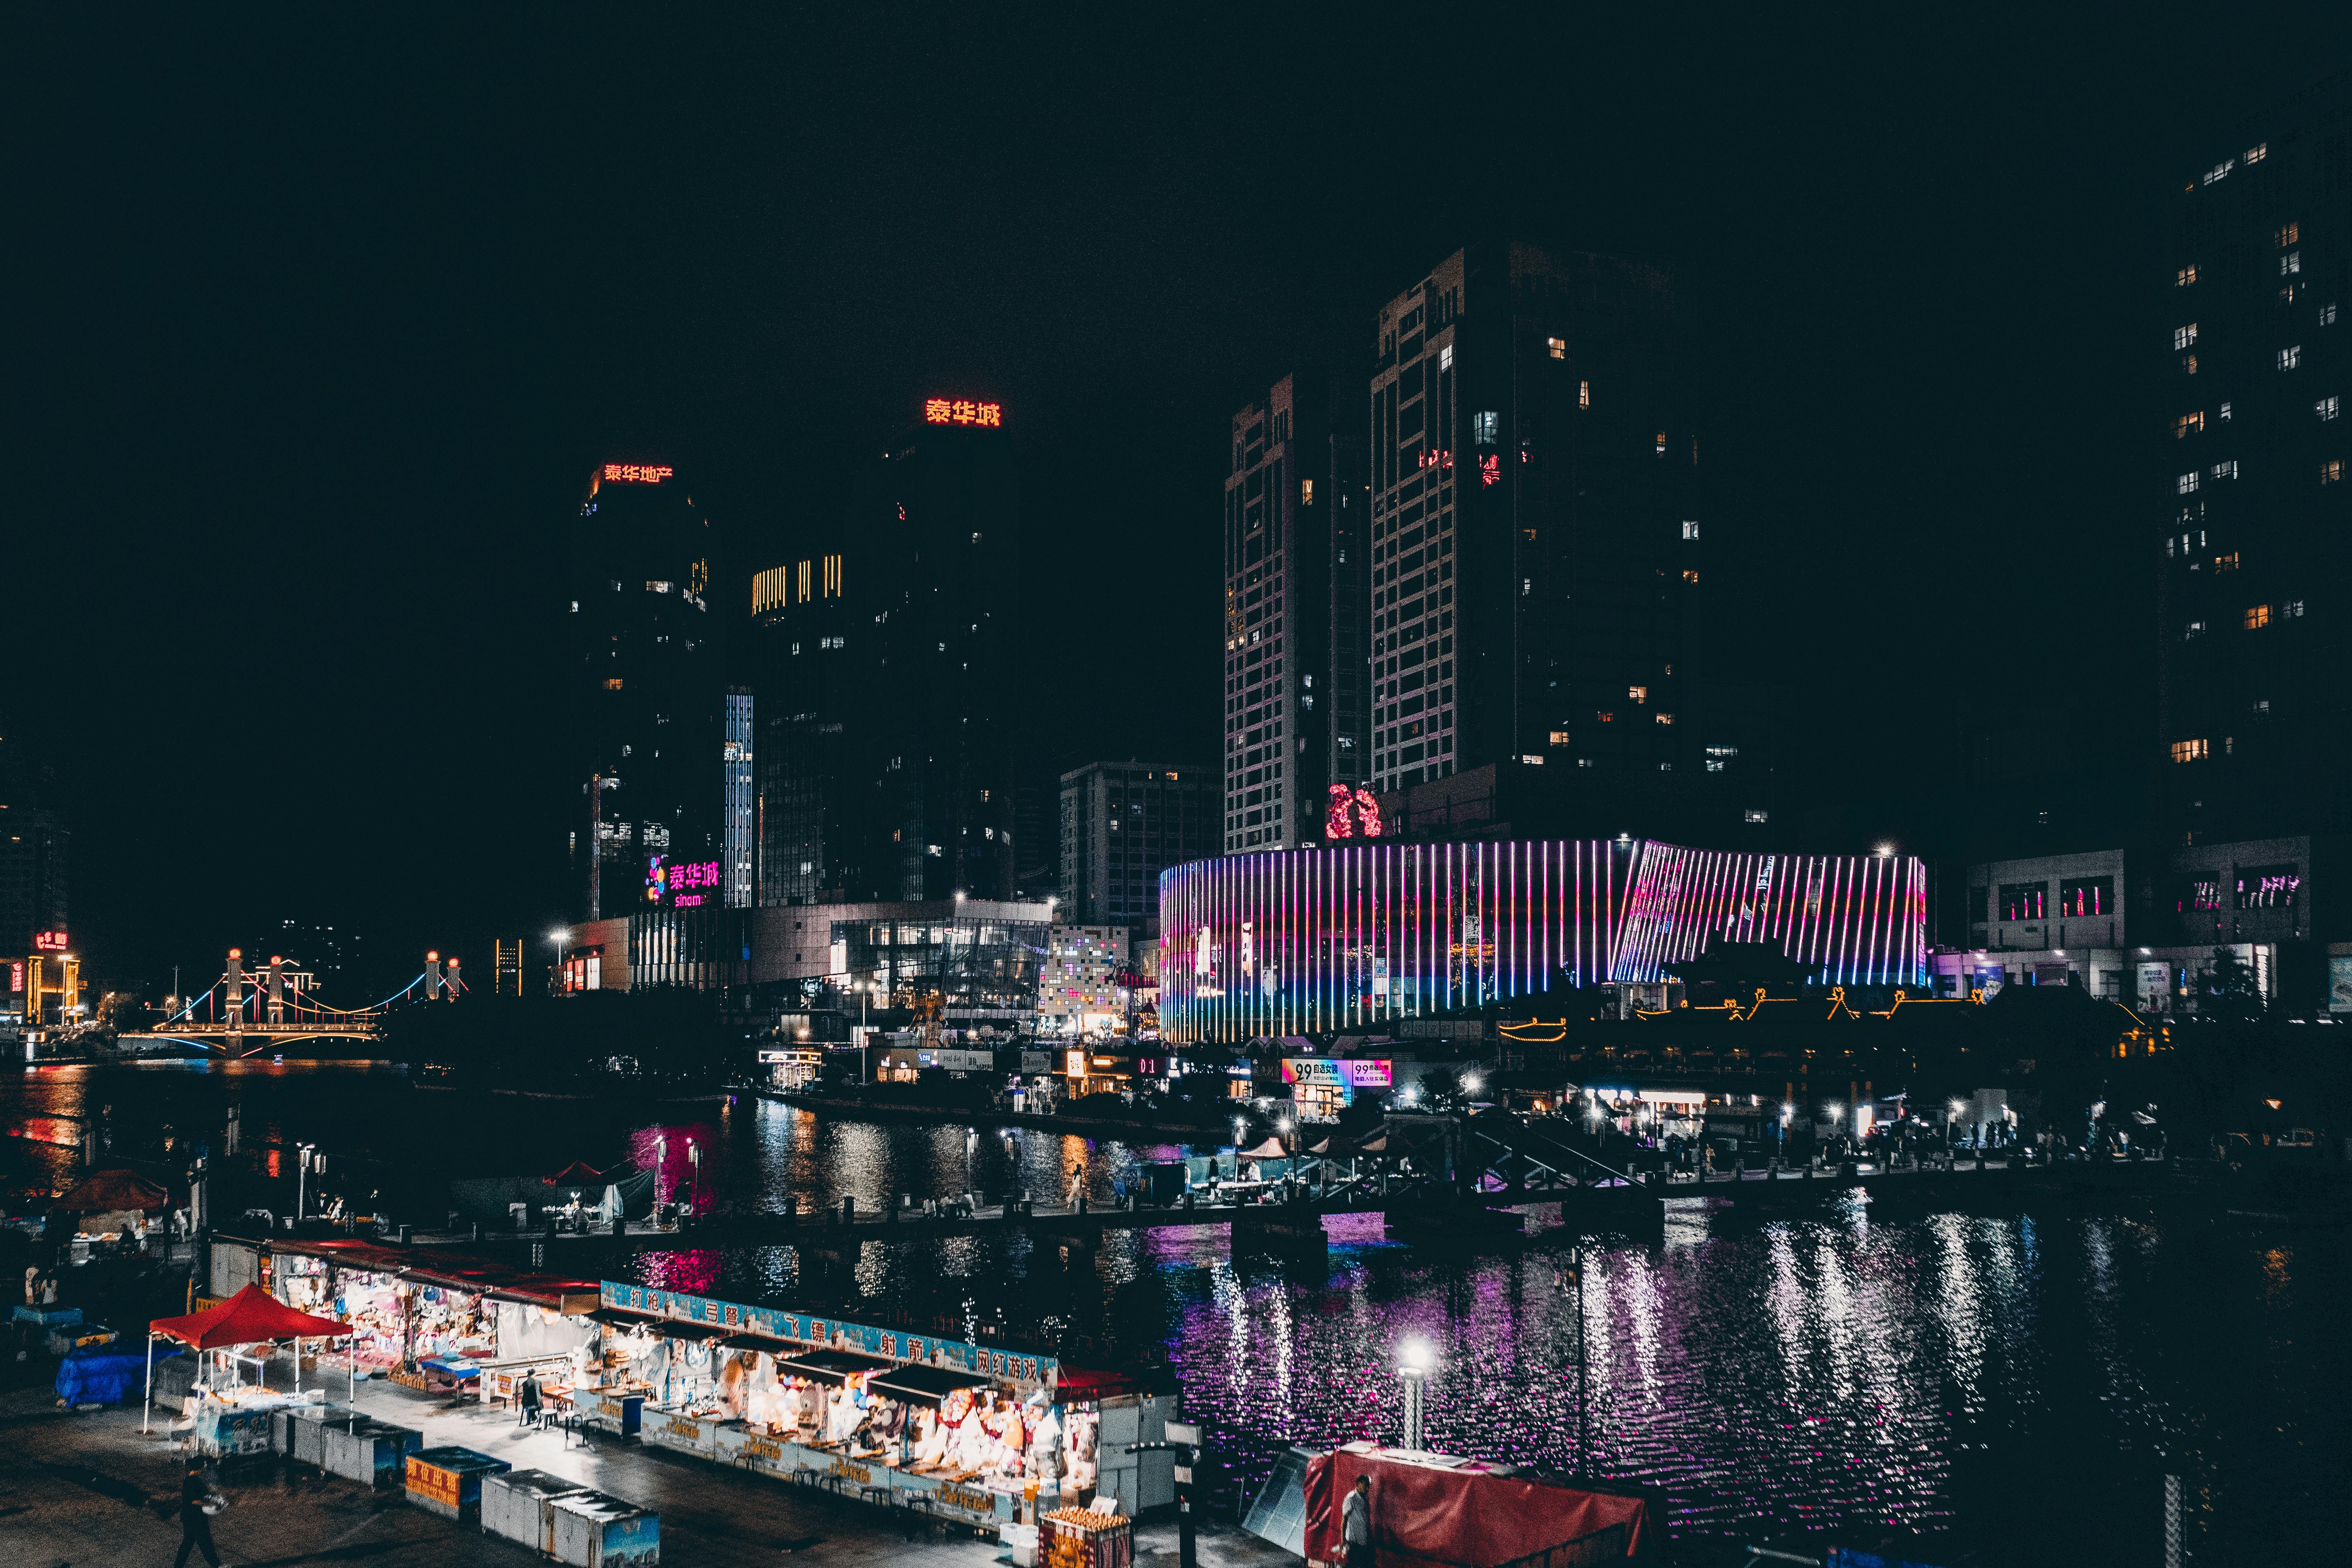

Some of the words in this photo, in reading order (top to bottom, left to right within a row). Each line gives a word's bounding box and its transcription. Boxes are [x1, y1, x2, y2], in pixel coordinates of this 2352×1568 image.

[926, 399, 1000, 426] 泰华城
[605, 464, 673, 483] 泰华地产
[670, 861, 719, 890] 泰华城
[1295, 1063, 1312, 1080] 99
[1313, 1064, 1338, 1074] 自选女装
[1355, 1065, 1369, 1074] 99
[630, 1289, 659, 1312] 打枪
[706, 1303, 738, 1326] 弓弩
[786, 1317, 825, 1343] 飞镖
[881, 1334, 923, 1361] 射箭
[977, 1350, 1037, 1382] 网红游戏
